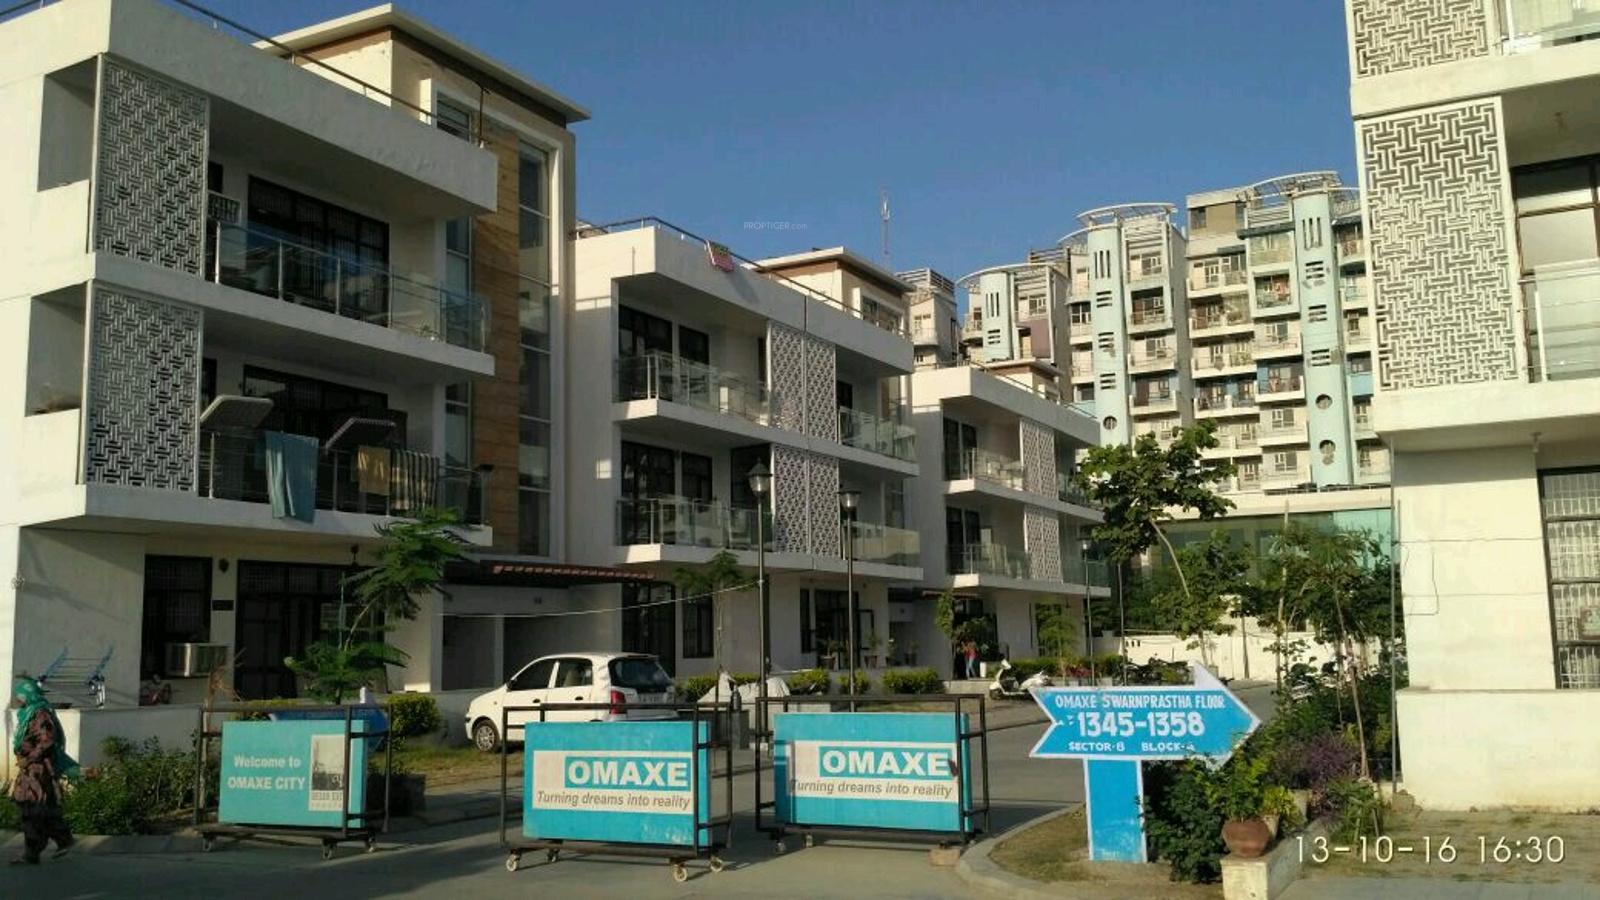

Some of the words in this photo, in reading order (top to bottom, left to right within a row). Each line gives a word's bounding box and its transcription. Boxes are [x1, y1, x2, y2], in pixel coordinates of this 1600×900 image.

[1056, 694, 1097, 709] OMAXE
[1078, 711, 1205, 737] 1345-1358
[234, 756, 286, 769] Welcome
[289, 757, 302, 768] to
[822, 750, 949, 776] OMAXE
[227, 776, 272, 789] OMAXE
[275, 777, 305, 790] CITY
[568, 761, 688, 787] OMAXE
[838, 781, 882, 793] dreams
[886, 782, 909, 795] into
[913, 783, 952, 799] reality
[538, 791, 578, 806] Turning
[582, 793, 624, 806] dreams
[627, 794, 649, 806] into
[653, 795, 690, 811] reality
